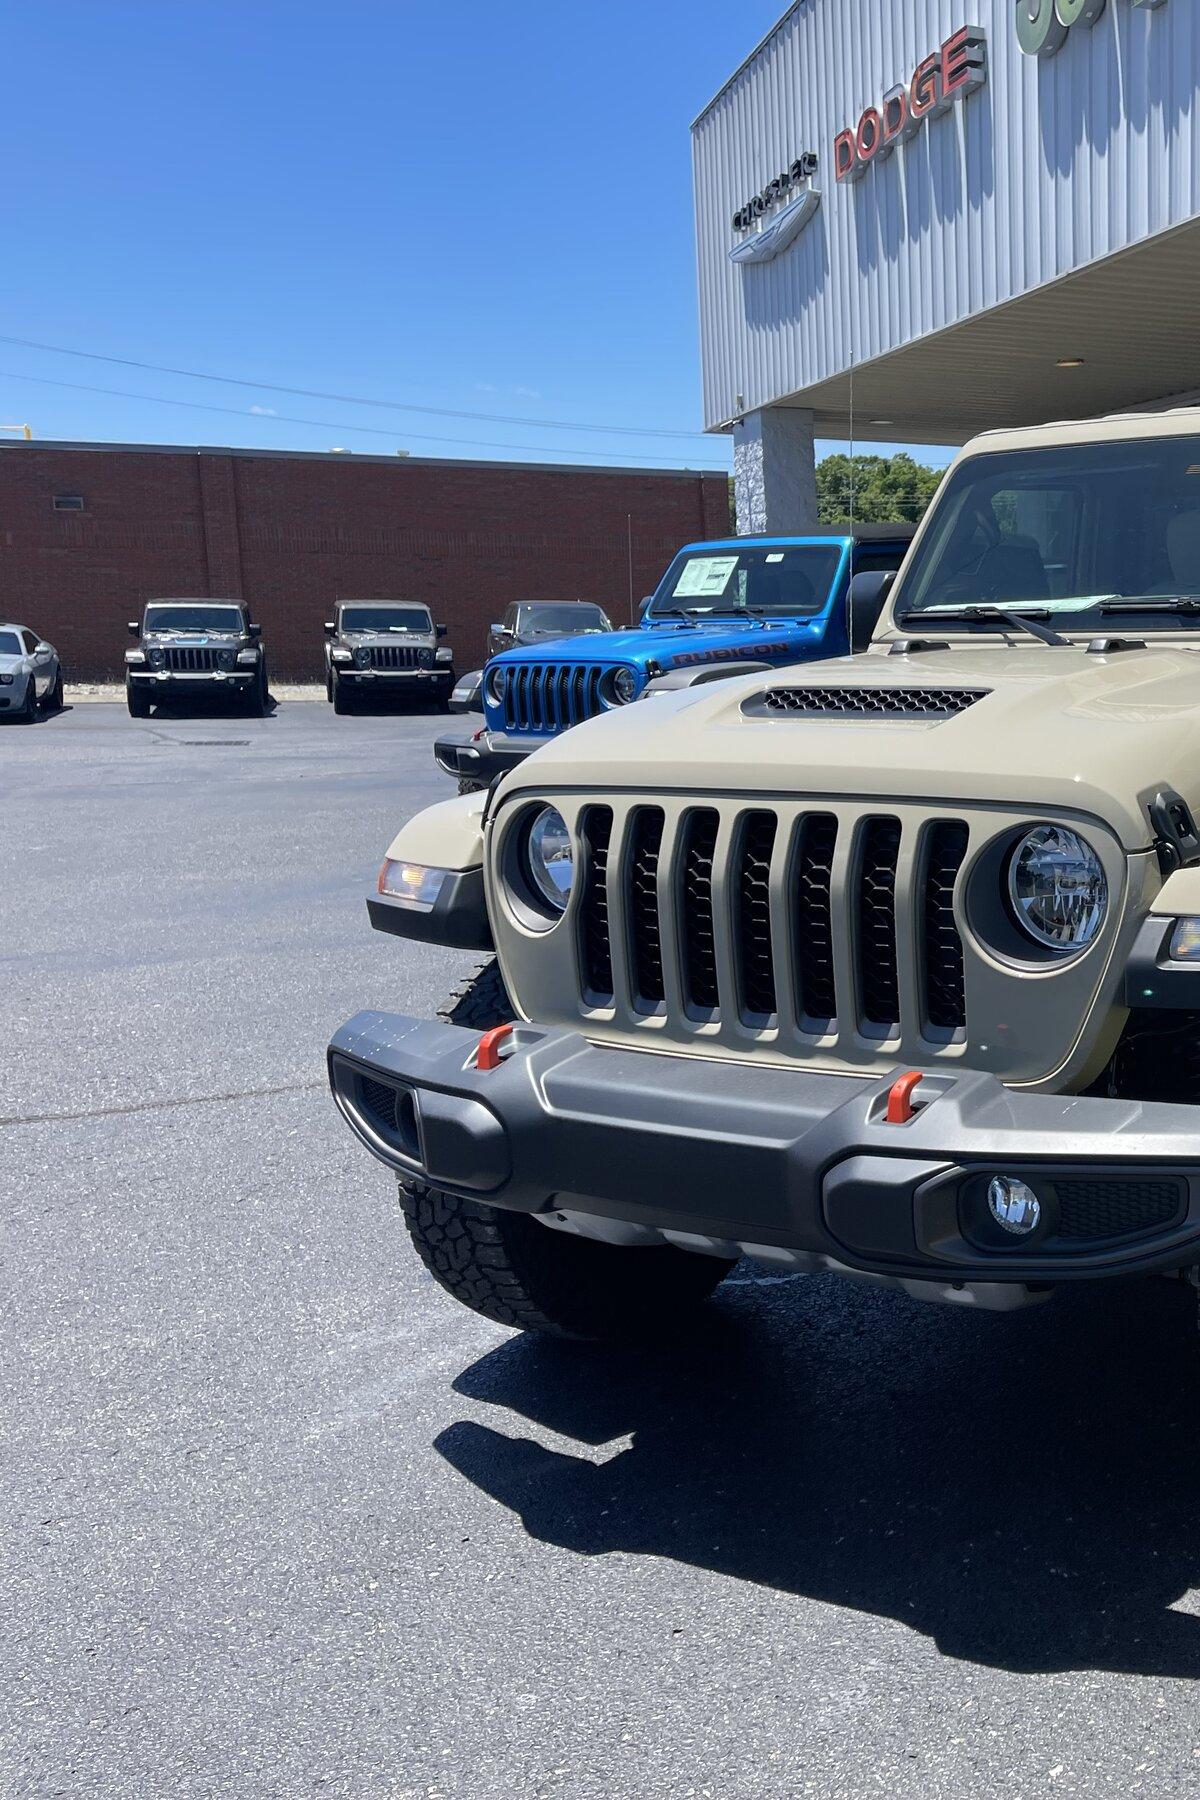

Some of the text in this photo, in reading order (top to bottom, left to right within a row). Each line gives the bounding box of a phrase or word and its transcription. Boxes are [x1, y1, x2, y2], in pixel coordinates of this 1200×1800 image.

[835, 25, 986, 183] DODGE
[732, 152, 818, 232] CHRYSLER
[672, 642, 789, 665] RUBICON
